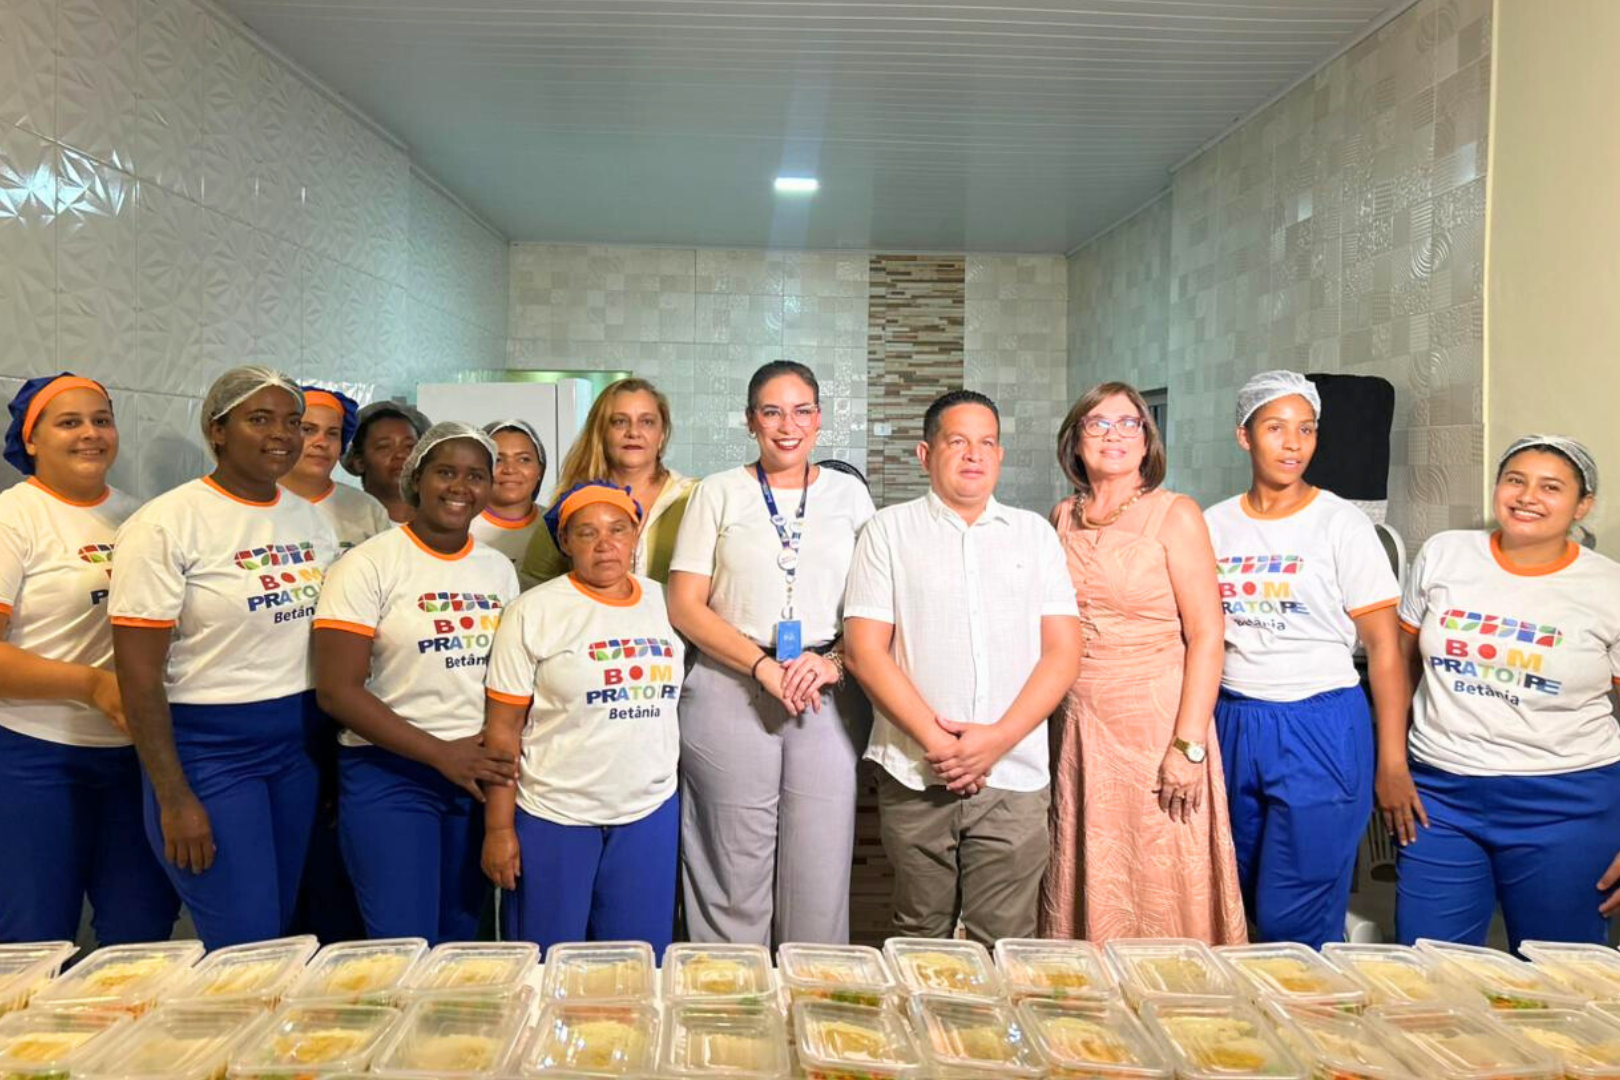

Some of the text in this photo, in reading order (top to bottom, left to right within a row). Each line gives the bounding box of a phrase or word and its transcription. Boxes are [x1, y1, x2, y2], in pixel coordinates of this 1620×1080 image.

[1218, 581, 1290, 598] BOM
[1221, 600, 1274, 615] RATO
[418, 634, 490, 654] PRATO
[1445, 638, 1544, 673] BOM
[604, 665, 672, 686] BOM
[1430, 656, 1563, 696] PRATO PE
[586, 685, 656, 704] PRATO
[609, 705, 661, 720] Betânia
